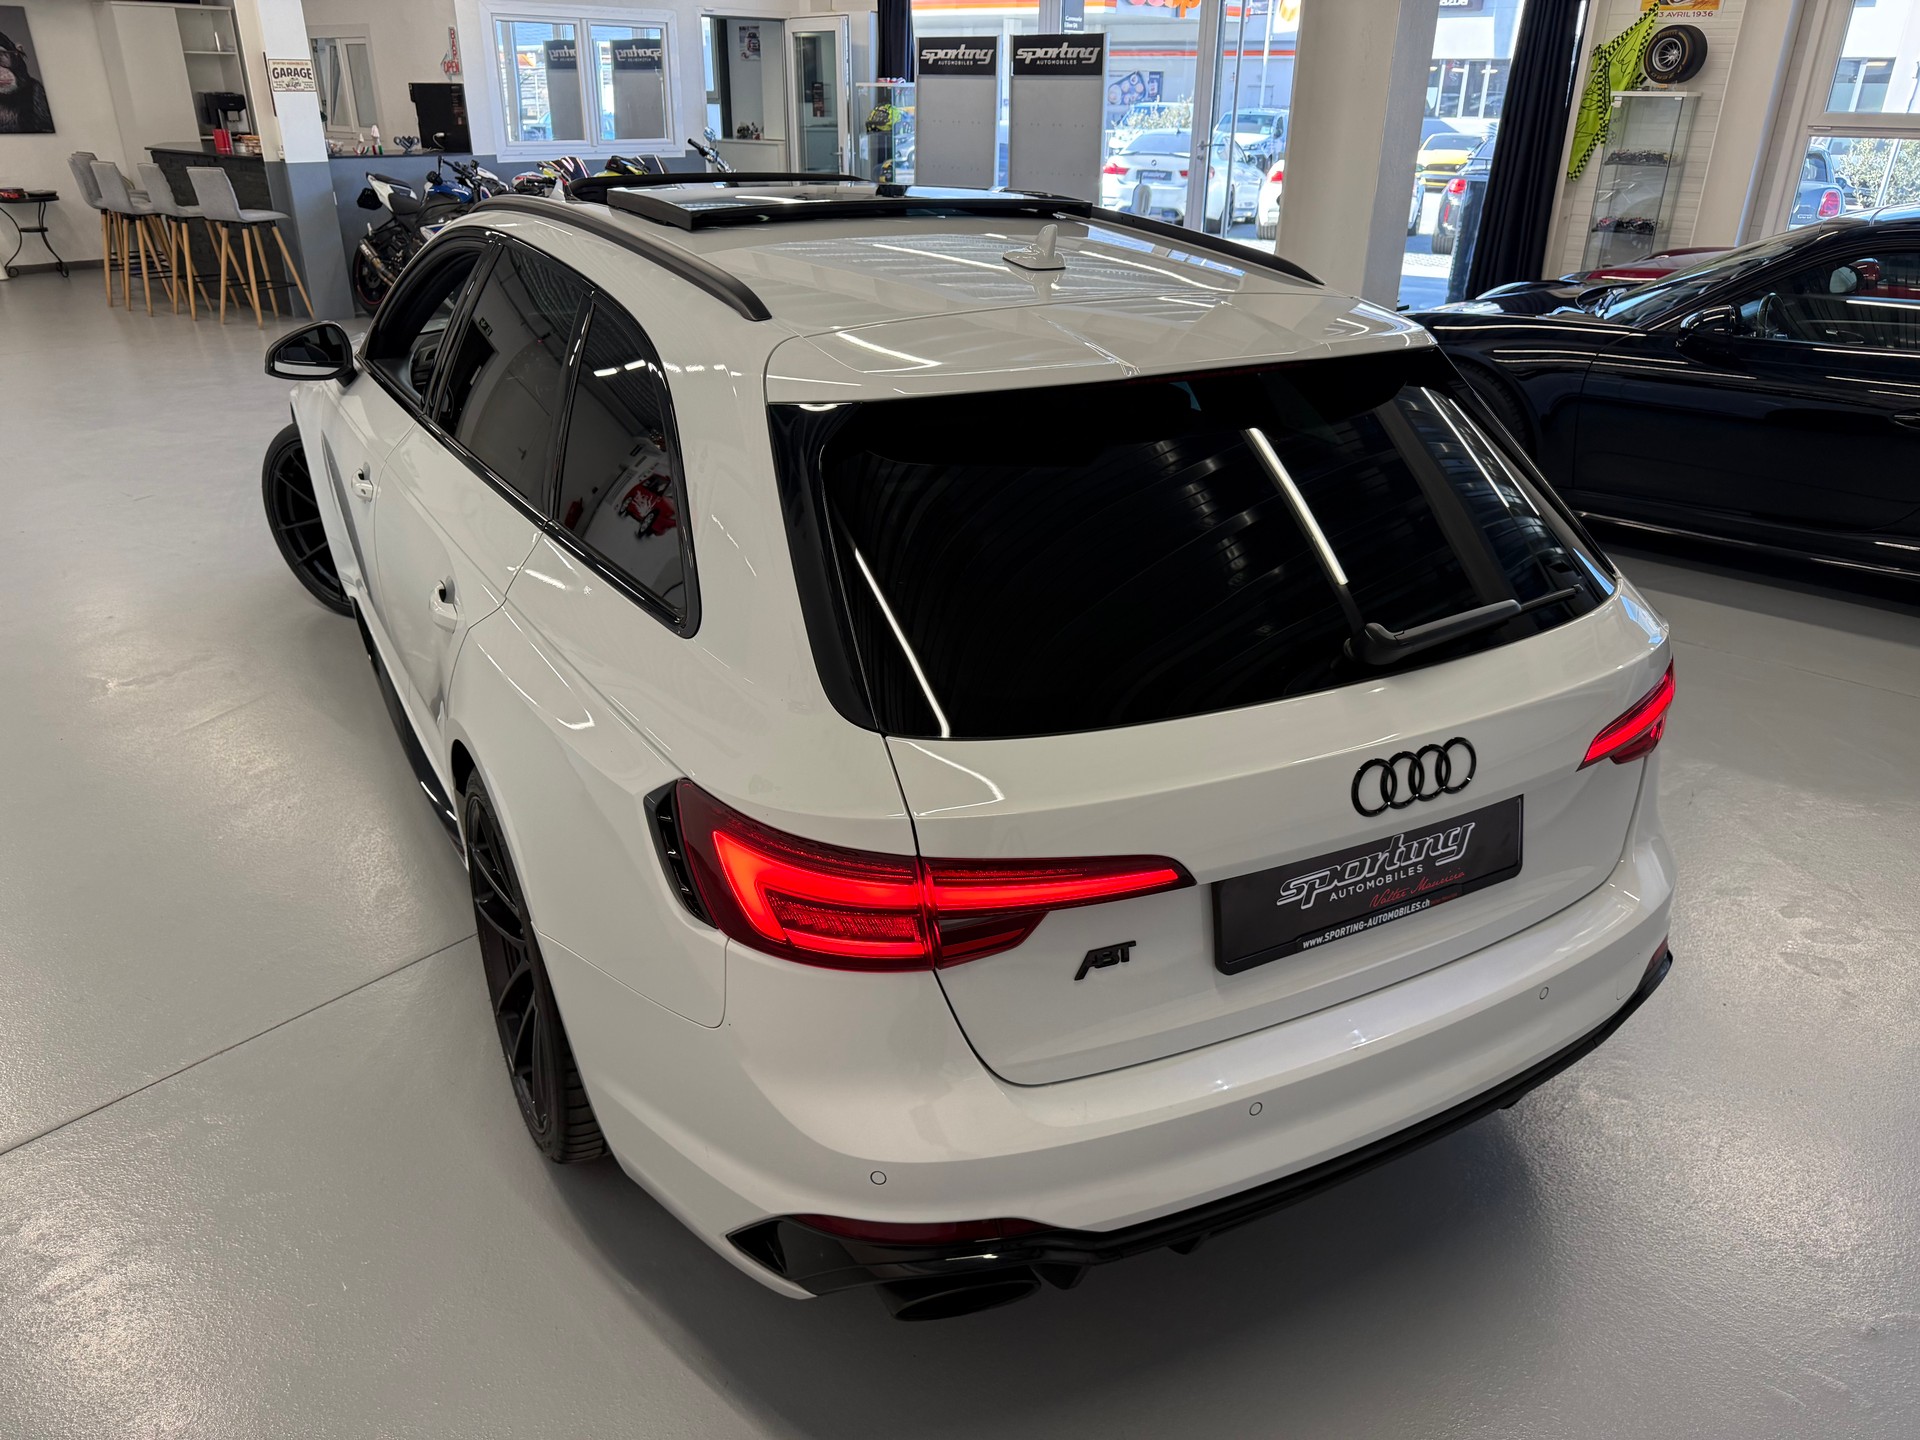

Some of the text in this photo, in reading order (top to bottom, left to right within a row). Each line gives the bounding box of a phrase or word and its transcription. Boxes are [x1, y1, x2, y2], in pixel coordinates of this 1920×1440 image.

[920, 44, 995, 65] sporting
[1015, 42, 1101, 64] sporting
[272, 67, 313, 80] GARAGE
[1276, 822, 1476, 910] sporting
[1329, 864, 1424, 902] AUTOMOBILES
[1302, 899, 1430, 949] www.SPORTING-AUTOMOBILES.ch
[1074, 940, 1137, 981] ABT
